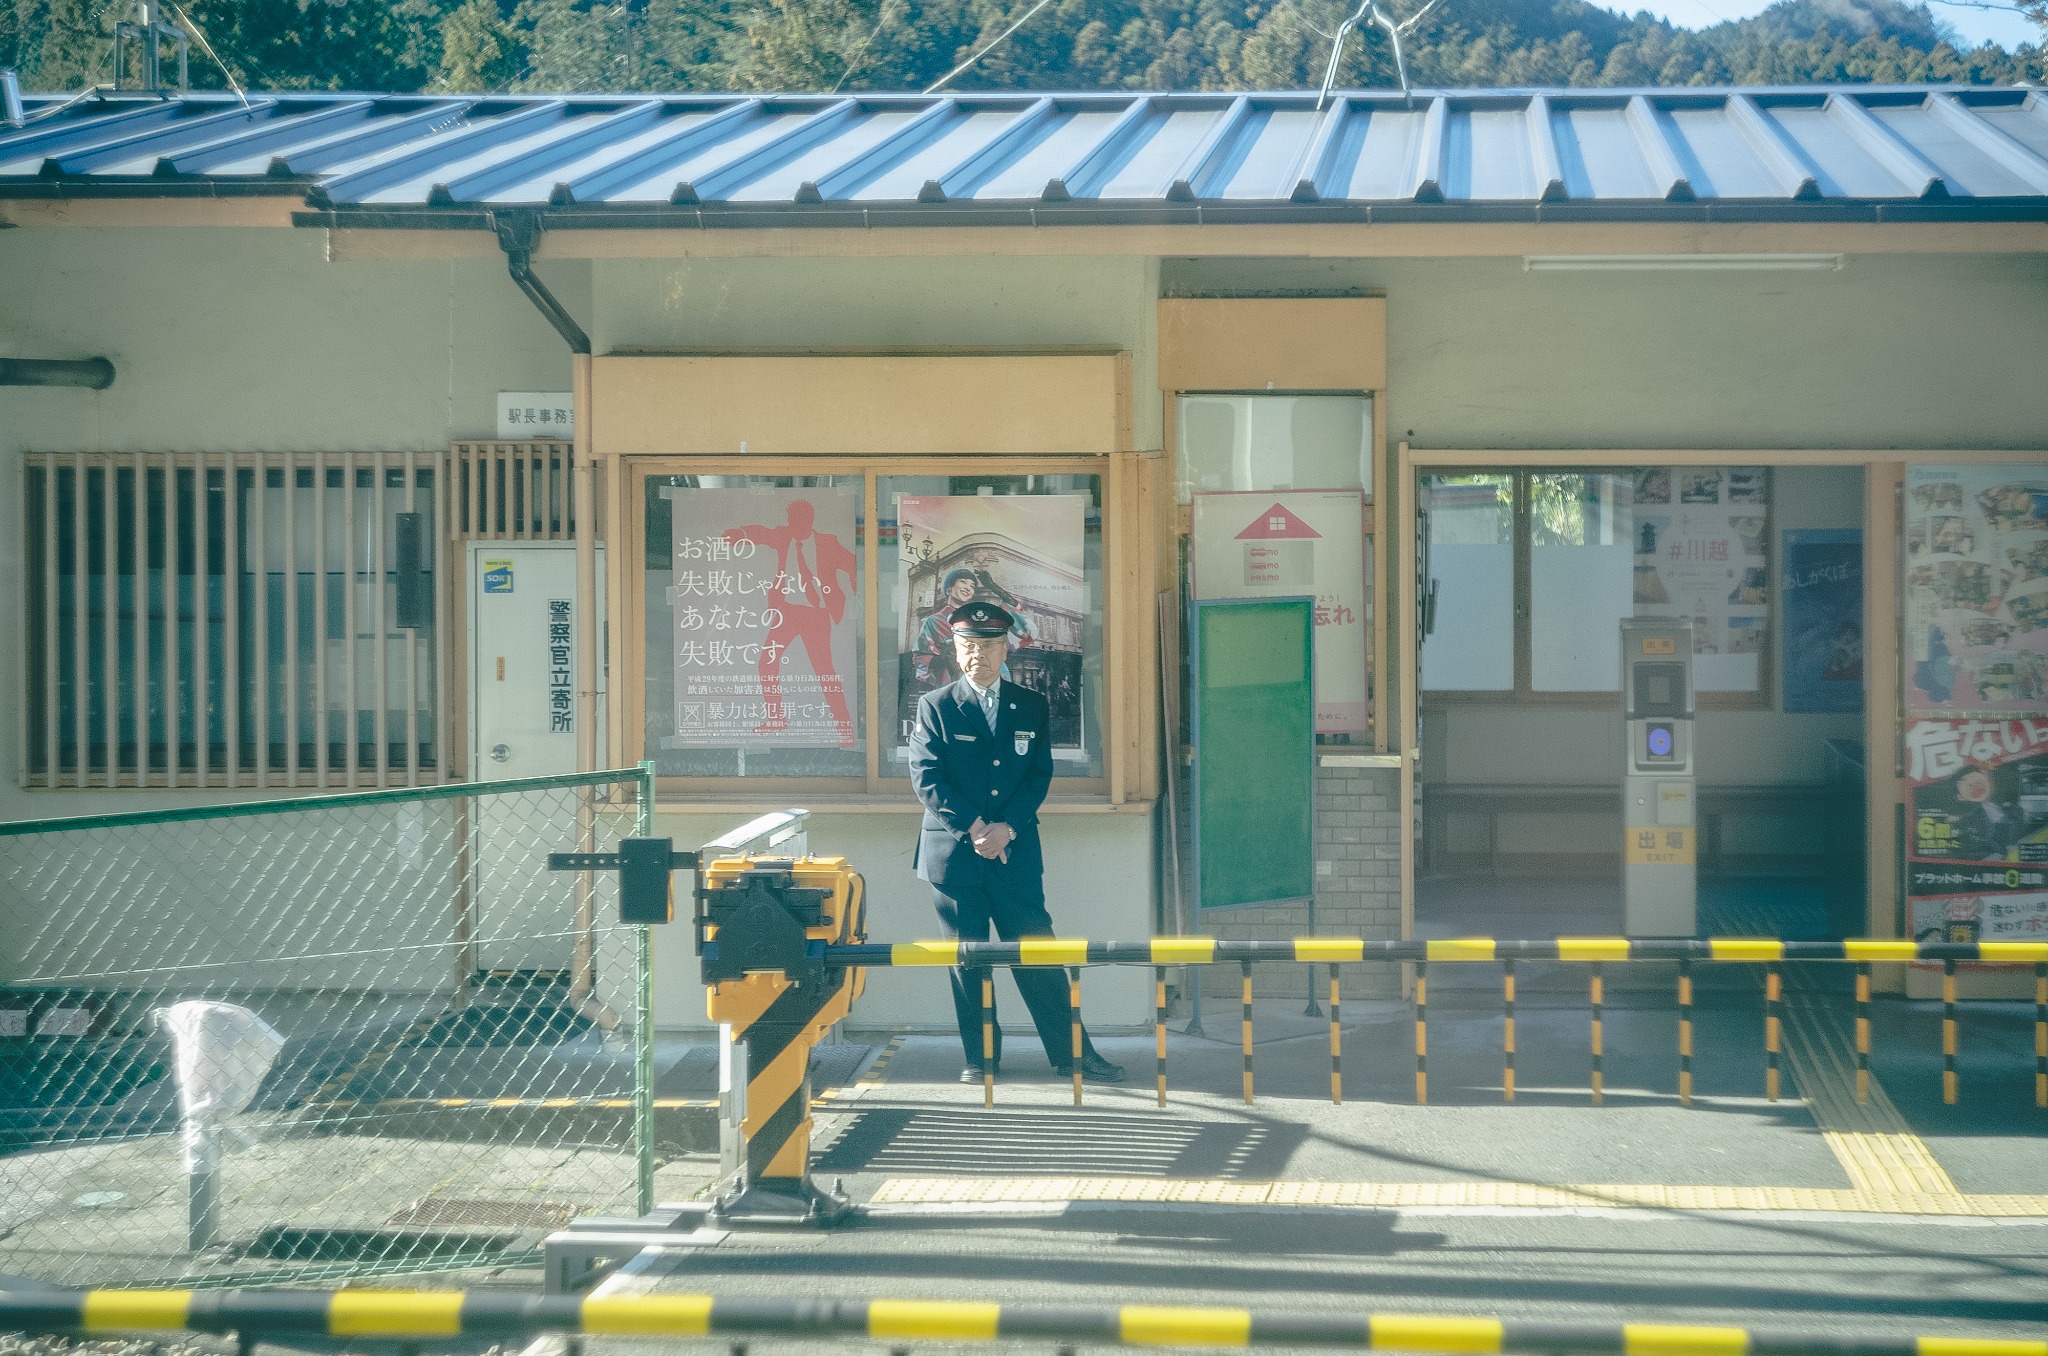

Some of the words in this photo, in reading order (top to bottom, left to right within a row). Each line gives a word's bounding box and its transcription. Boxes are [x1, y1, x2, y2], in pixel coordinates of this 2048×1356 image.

[677, 535, 756, 562] お酒の
[1669, 540, 1729, 562] #川越
[677, 570, 831, 598] 失敗じゃない。
[680, 604, 784, 630] あなたの
[550, 600, 572, 732] 警察官立寄所
[679, 640, 790, 667] 失敗です。
[706, 702, 835, 720] 暴力は犯罪です。
[1647, 852, 1674, 862] EXIT
